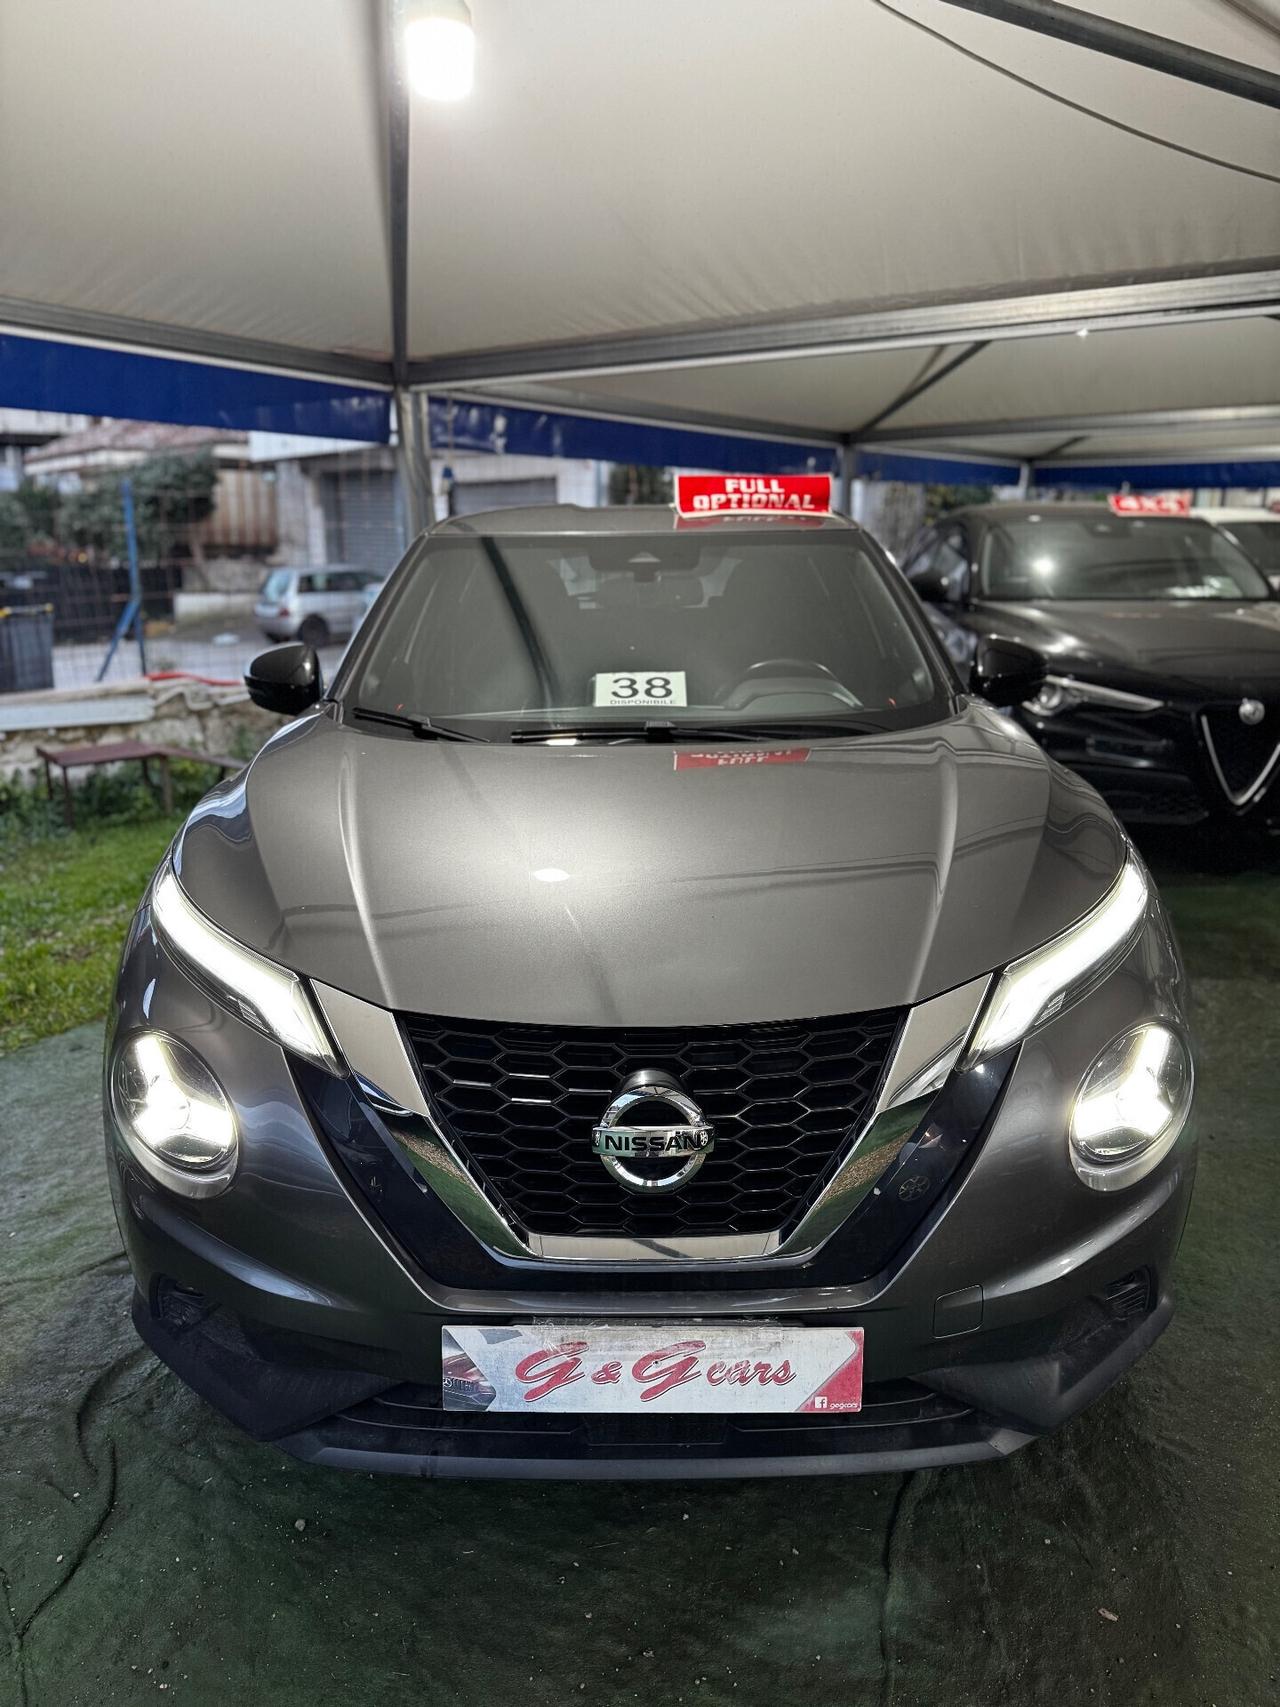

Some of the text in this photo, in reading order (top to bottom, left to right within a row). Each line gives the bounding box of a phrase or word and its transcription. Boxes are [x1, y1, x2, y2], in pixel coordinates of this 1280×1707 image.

[725, 478, 784, 493] FULL
[693, 494, 815, 509] OPTIONAL
[611, 676, 673, 698] 38
[605, 1134, 701, 1151] NISSAN
[515, 1340, 797, 1402] G & G cars
